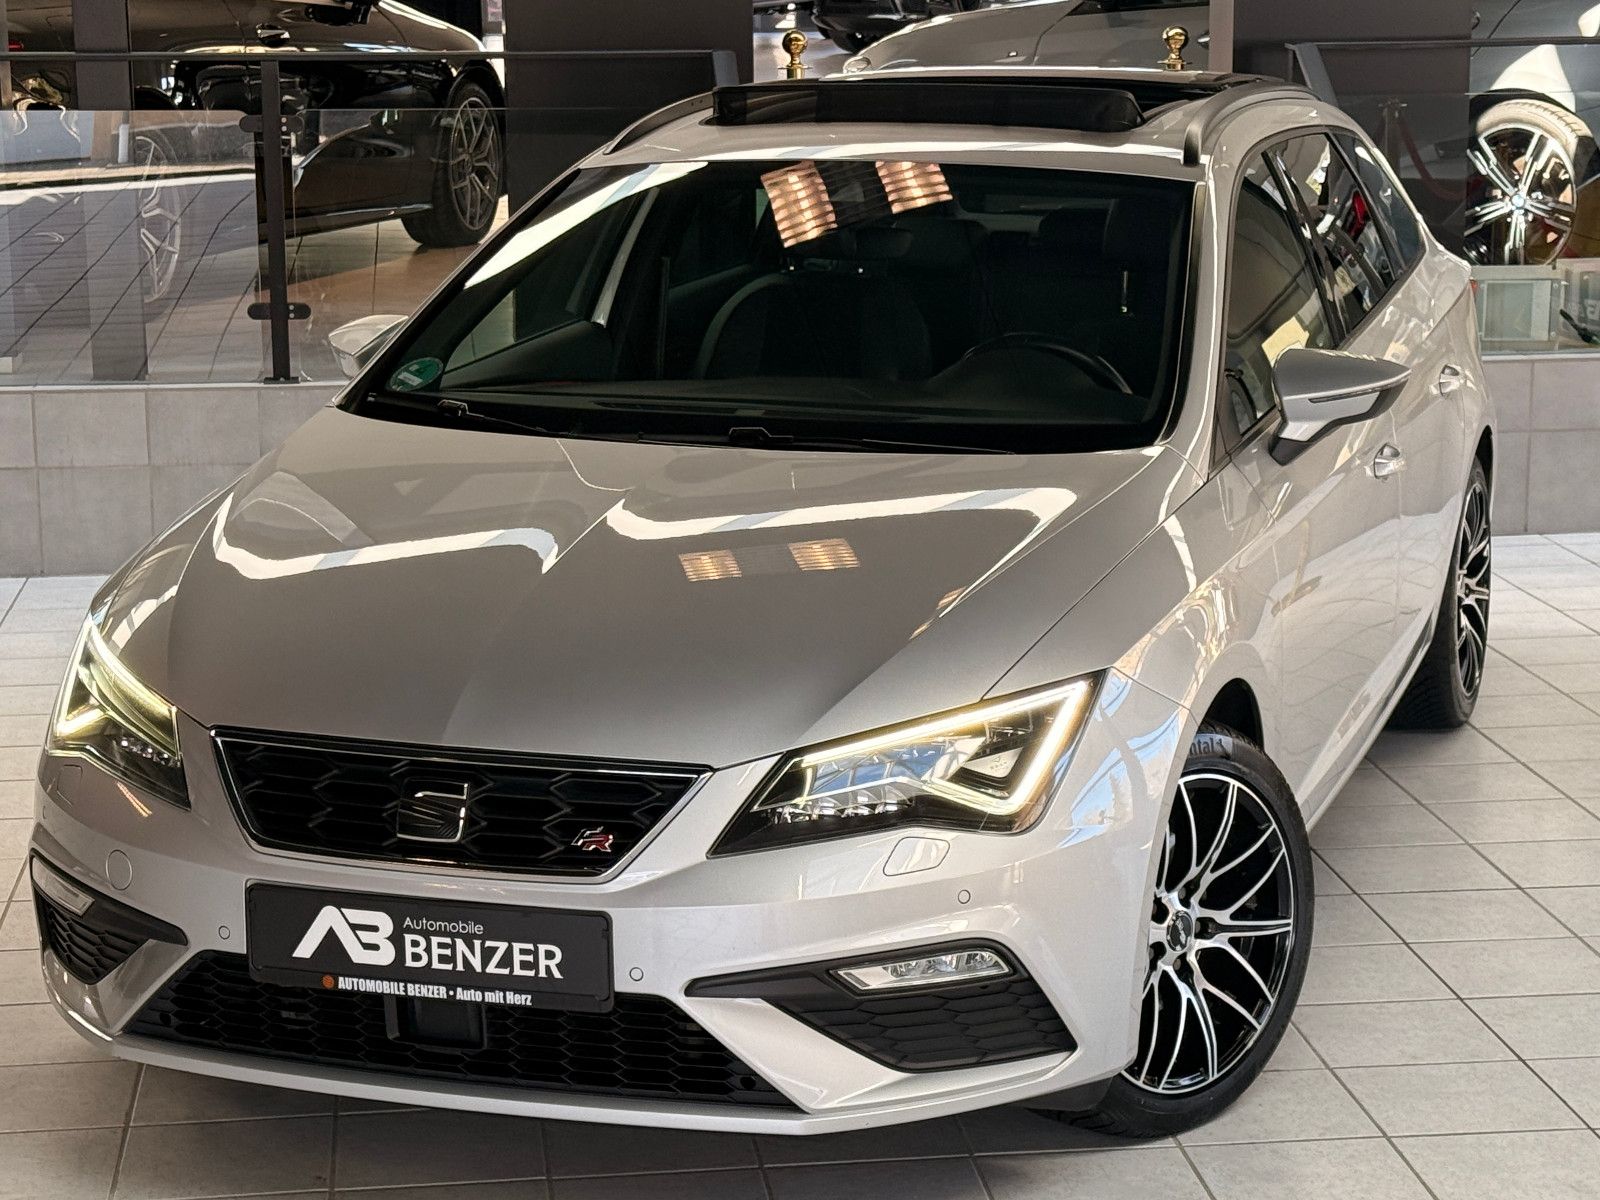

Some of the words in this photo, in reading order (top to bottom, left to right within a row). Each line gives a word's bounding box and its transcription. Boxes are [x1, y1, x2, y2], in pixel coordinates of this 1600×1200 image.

[403, 916, 484, 935] Automobile
[403, 933, 564, 979] BENZER
[338, 976, 405, 996] AUTOMOBILE
[406, 984, 447, 999] BENZER
[456, 987, 483, 1003] Auto
[484, 991, 504, 1004] mit
[505, 991, 533, 1006] Herz
